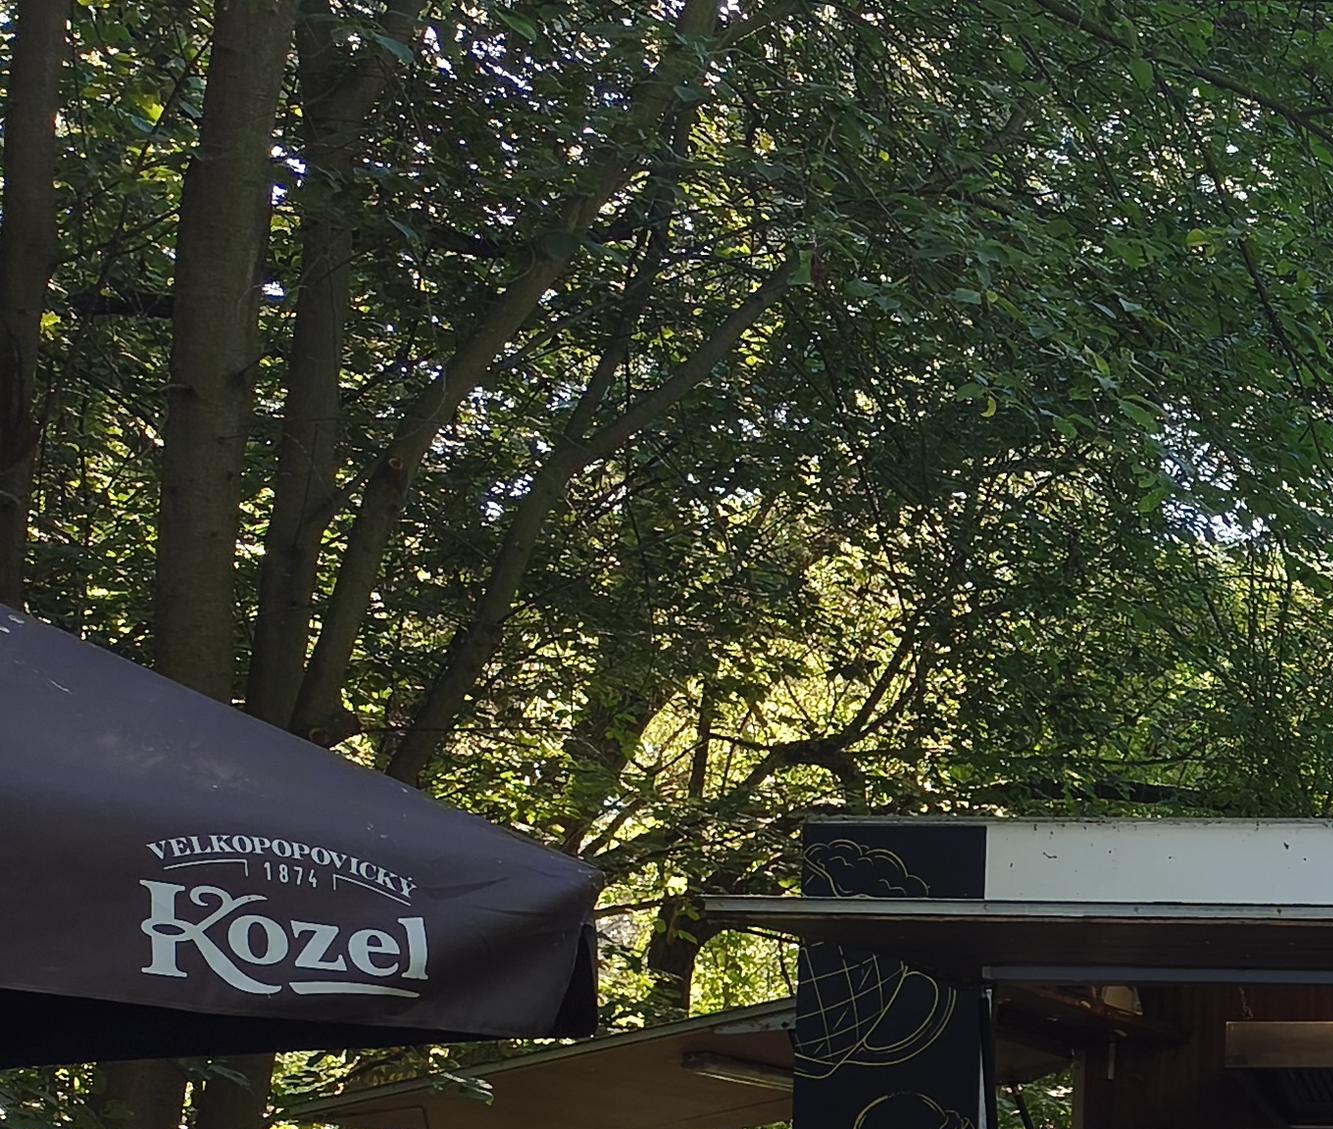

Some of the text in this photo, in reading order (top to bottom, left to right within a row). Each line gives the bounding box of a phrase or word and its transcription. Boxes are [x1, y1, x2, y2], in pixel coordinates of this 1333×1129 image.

[146, 834, 417, 899] VELKOPOPOVICKÝ
[264, 862, 317, 887] 1874
[139, 880, 429, 995] Kozel
